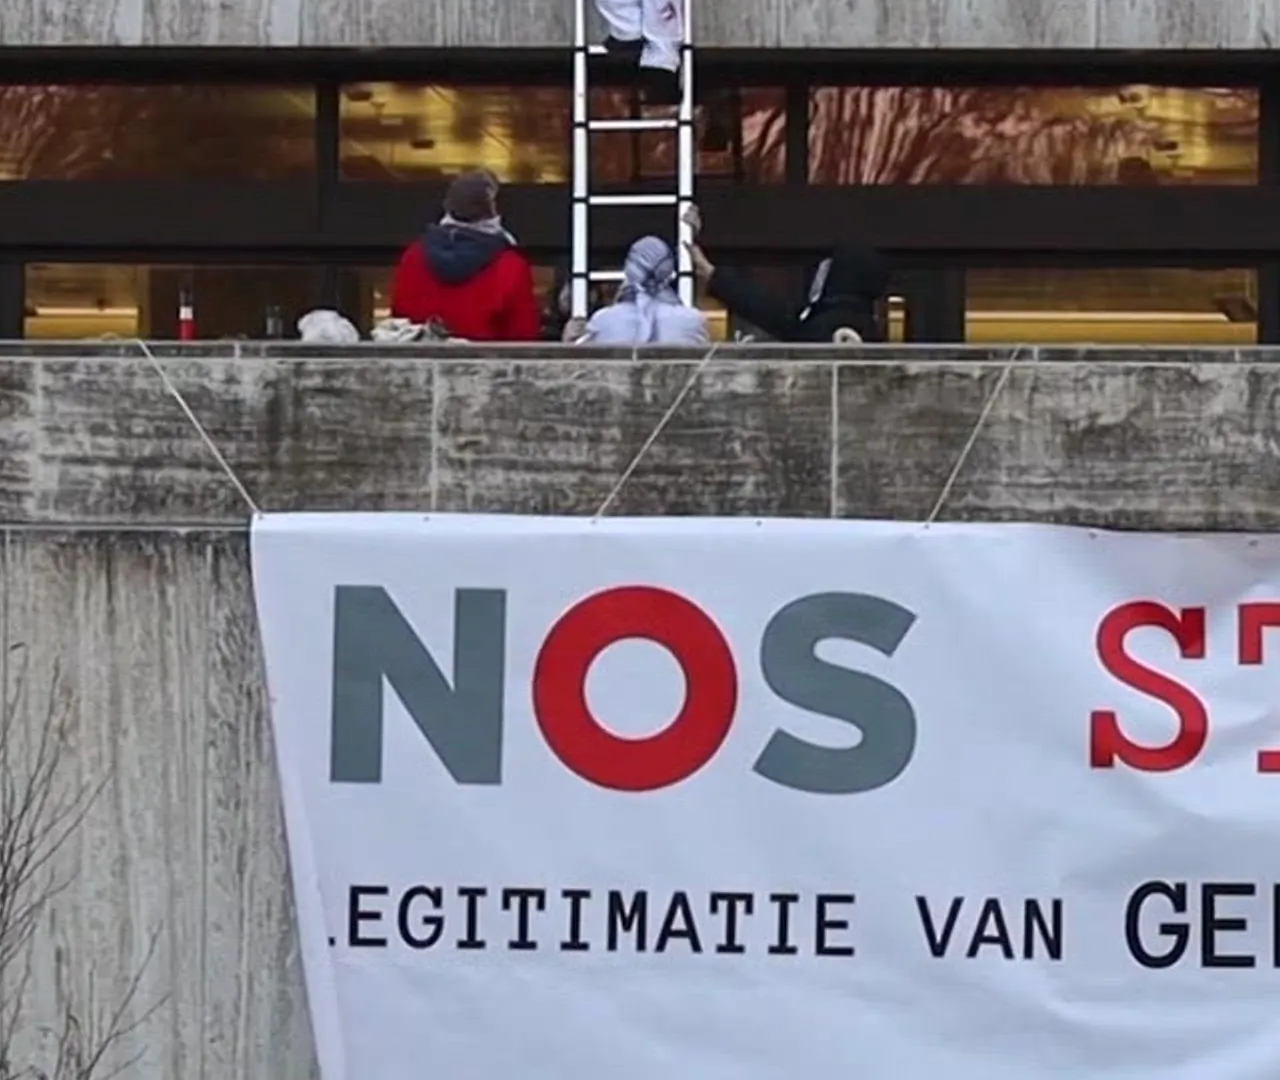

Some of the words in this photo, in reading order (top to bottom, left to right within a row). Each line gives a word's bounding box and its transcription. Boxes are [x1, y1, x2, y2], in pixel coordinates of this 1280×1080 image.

[328, 584, 919, 795] NOS
[328, 884, 858, 957] EGITIMATIE
[915, 894, 1064, 962] VAN
